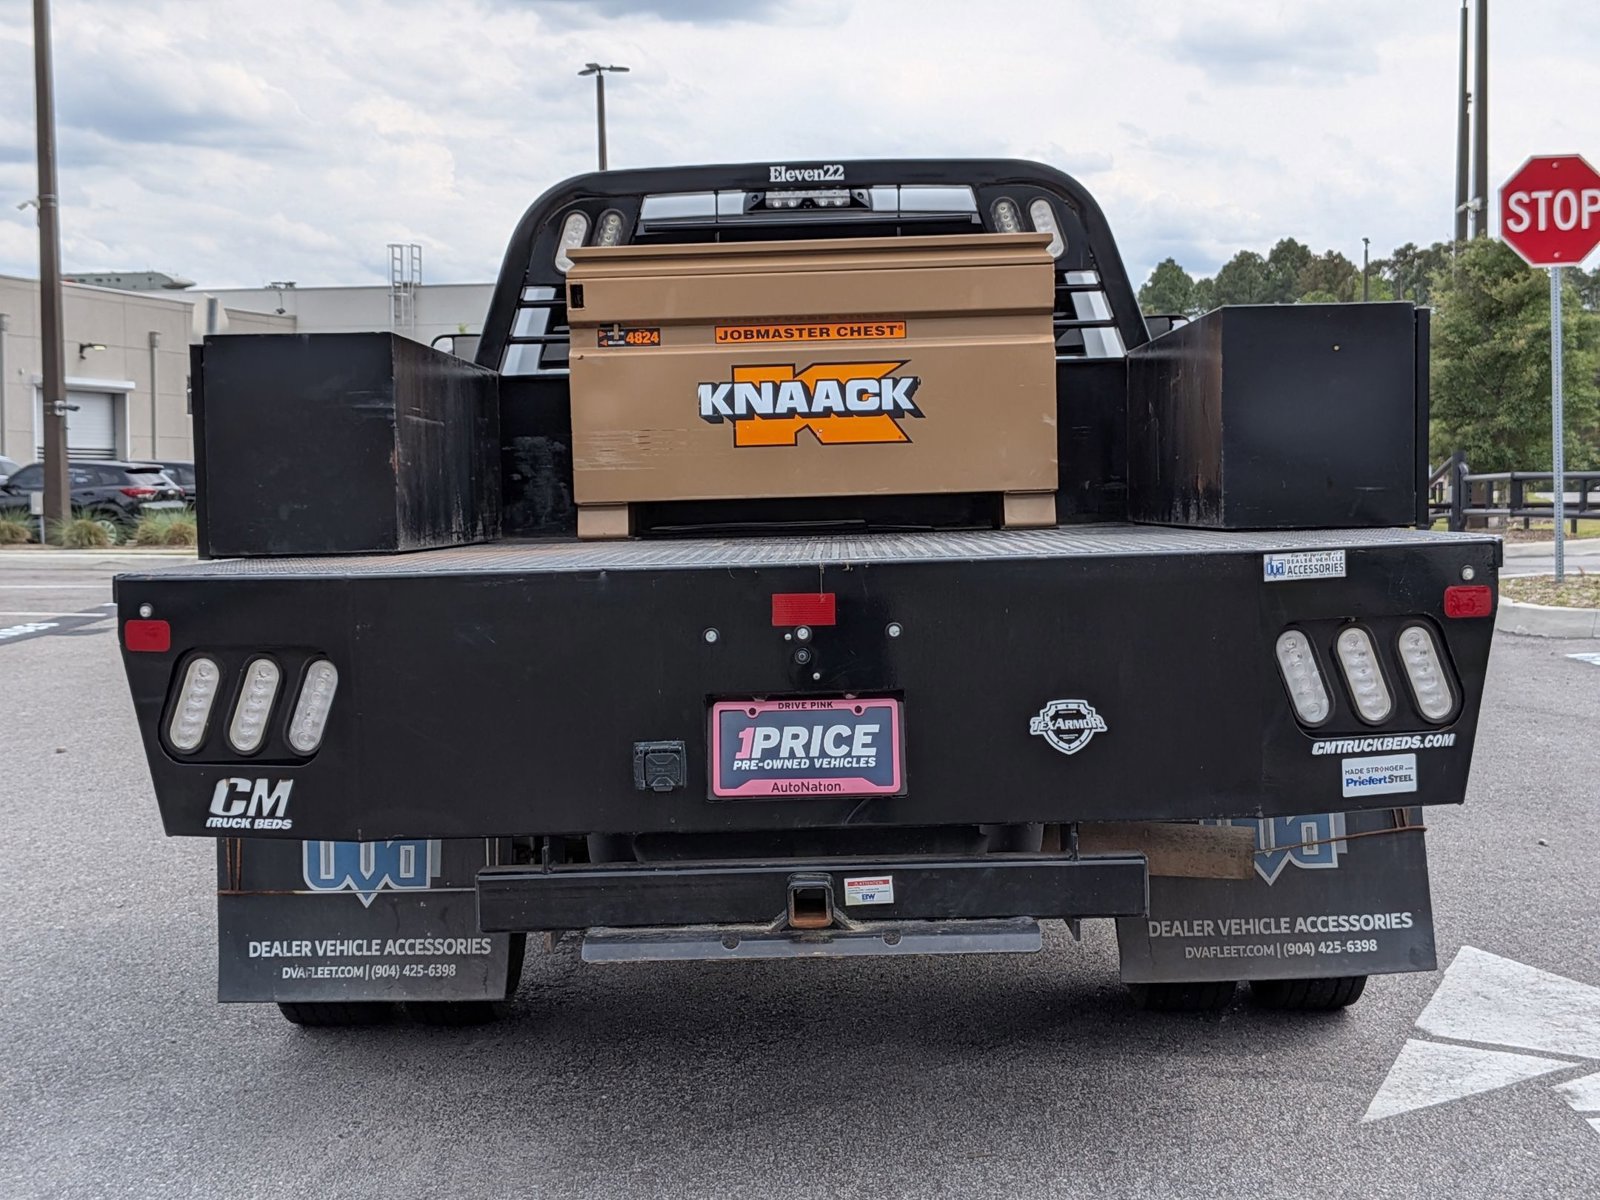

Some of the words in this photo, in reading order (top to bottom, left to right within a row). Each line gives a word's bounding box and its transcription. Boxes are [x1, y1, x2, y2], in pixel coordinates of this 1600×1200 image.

[769, 164, 845, 182] Eleven22
[1506, 188, 1600, 233] STOP
[625, 331, 659, 344] 4824
[718, 327, 831, 341] JOBMASTER
[698, 376, 919, 418] KNAACK
[1286, 557, 1313, 565] DEALER
[1287, 562, 1344, 575] ACCESSORIES
[778, 701, 808, 710] DRIVE
[810, 701, 834, 709] PINK
[735, 724, 881, 760] 1PRICE
[1311, 733, 1456, 755] CMTRUCKBEDS.COM
[733, 758, 810, 771] PRE-OWNED
[814, 757, 877, 768] VEHICLES
[1345, 767, 1365, 775] MADE
[1366, 765, 1404, 774] STRONGER
[209, 777, 294, 817] CM
[205, 816, 252, 829] TRUCK
[253, 818, 293, 830] BEDS
[1149, 919, 1214, 938] DEALER
[1217, 916, 1291, 936] VEHICLE
[1294, 911, 1414, 934] ACCESSORIES
[249, 940, 312, 958] DEALER
[315, 939, 382, 957] VEHICLE
[383, 937, 492, 956] ACCESSORIES
[1185, 944, 1275, 959] DVAFLEET.COM
[1283, 942, 1315, 957] (904)
[1318, 939, 1378, 954] 425-6398
[370, 964, 400, 979] (904)
[402, 963, 457, 977] 425-6398
